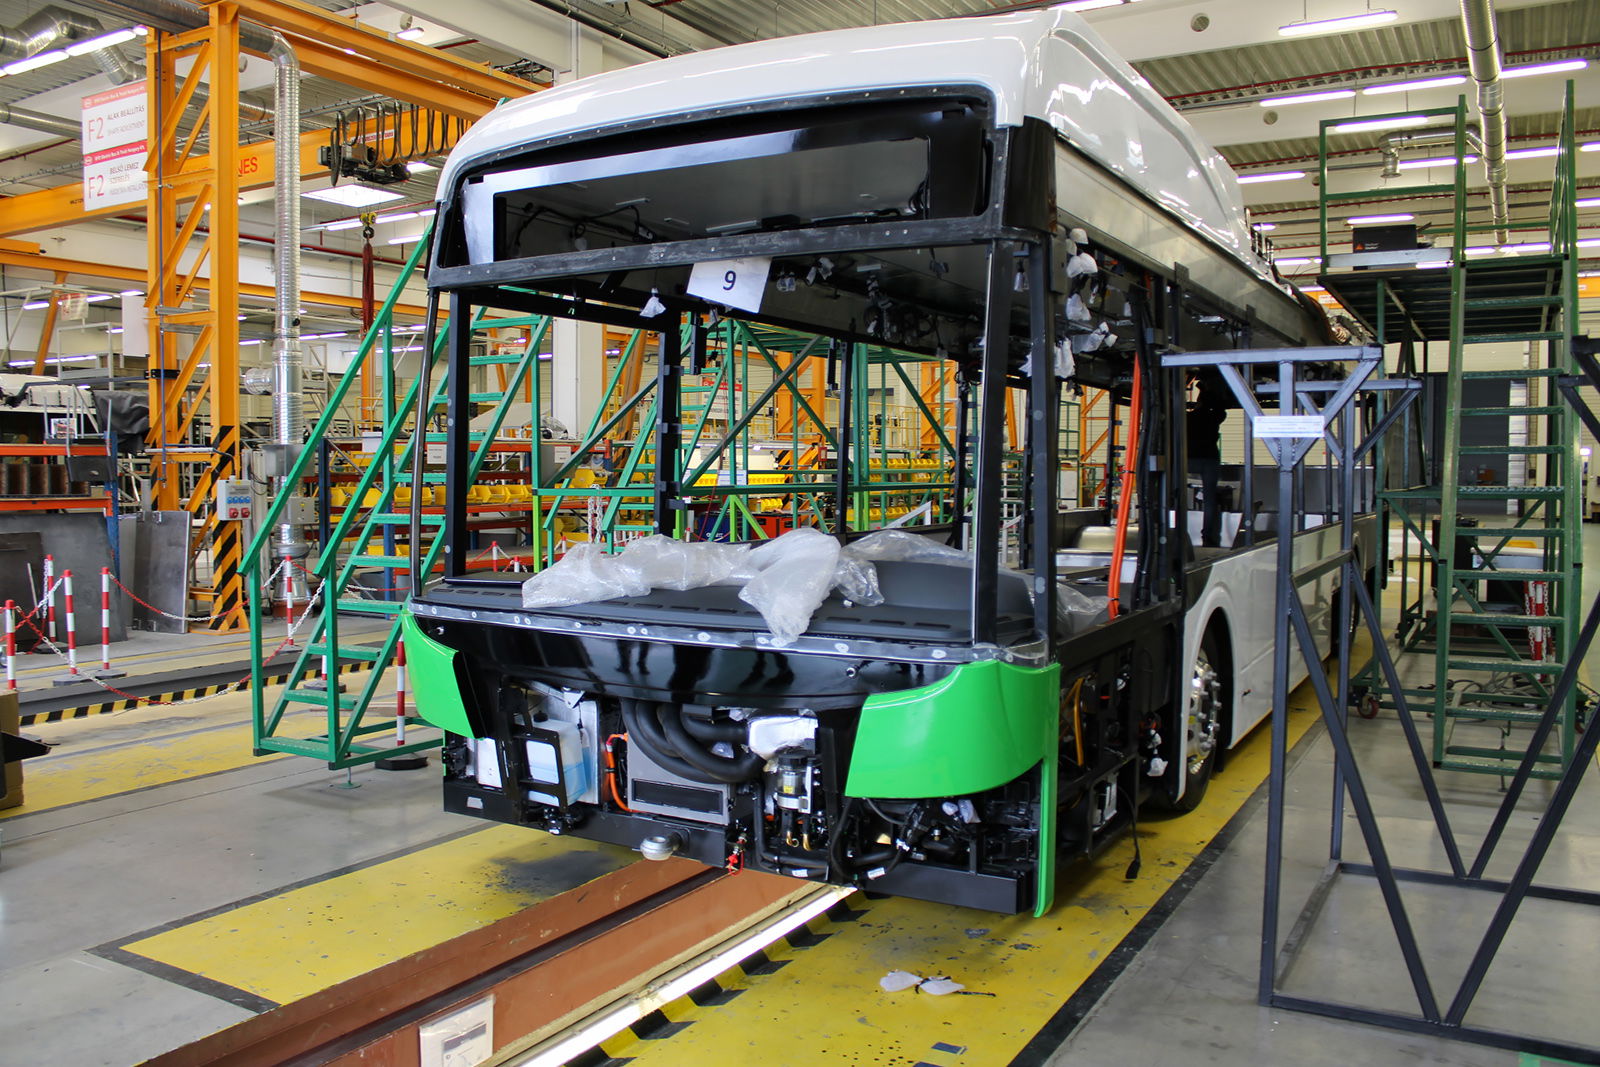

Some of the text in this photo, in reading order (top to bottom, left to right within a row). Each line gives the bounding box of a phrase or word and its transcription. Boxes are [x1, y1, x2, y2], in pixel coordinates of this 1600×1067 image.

[88, 117, 104, 142] F2
[88, 174, 105, 199] F2
[722, 270, 737, 291] 9
